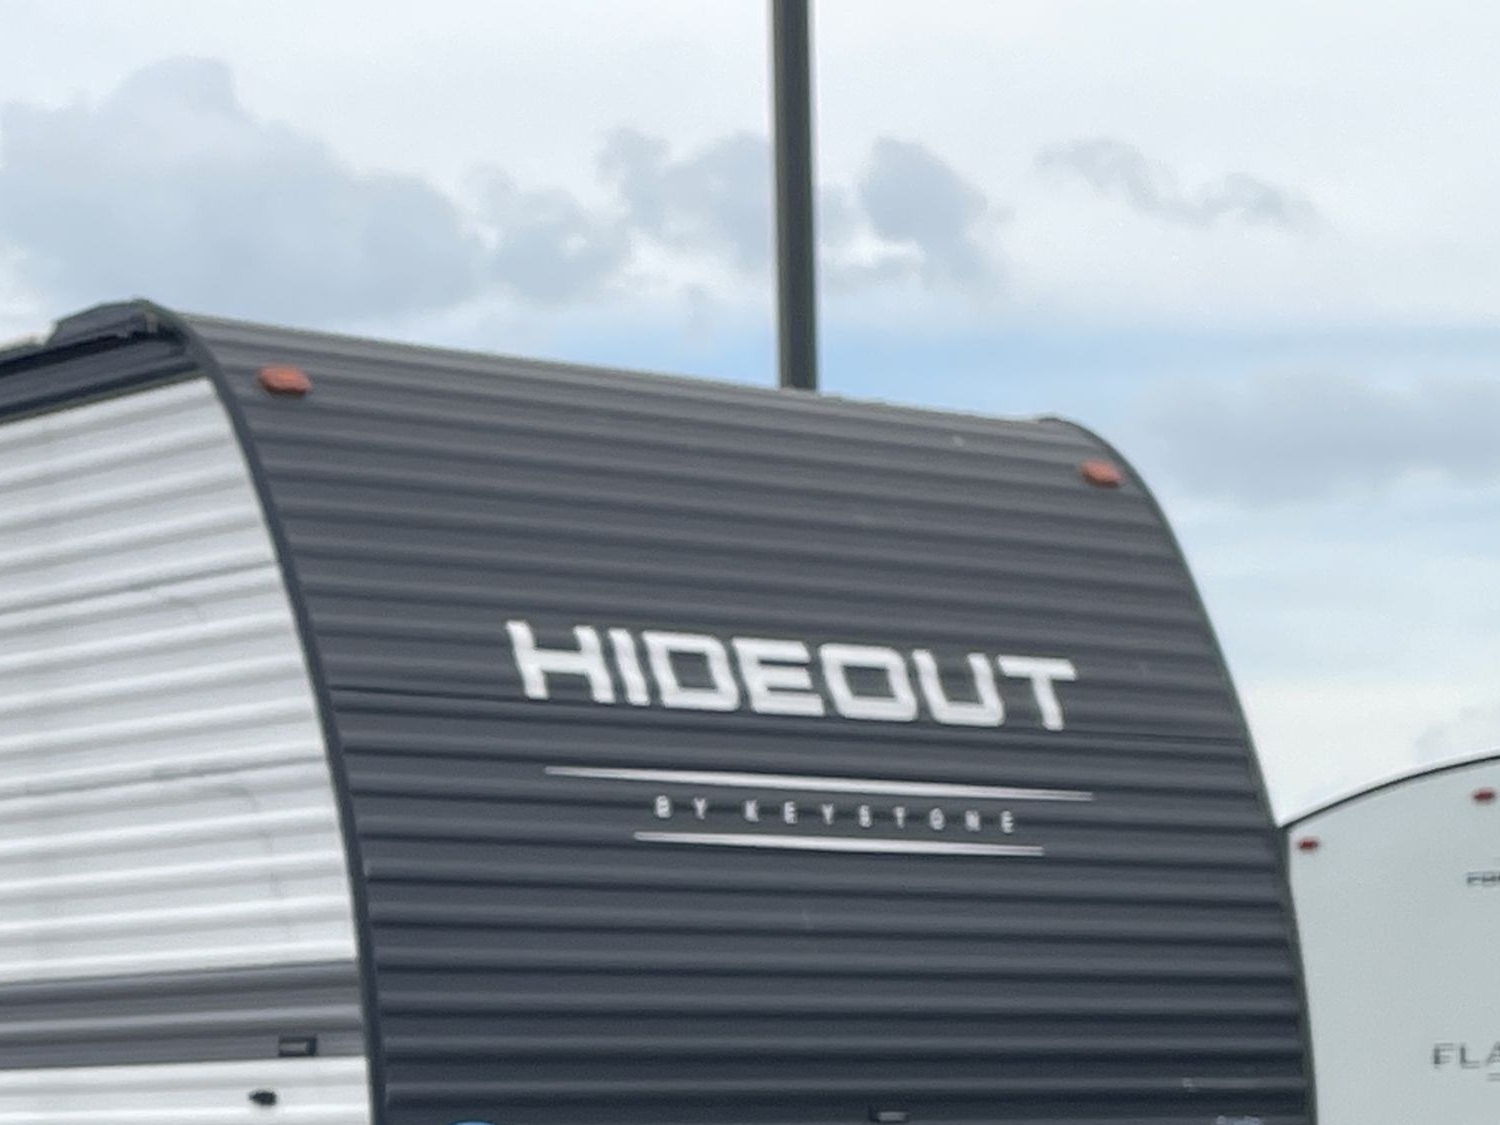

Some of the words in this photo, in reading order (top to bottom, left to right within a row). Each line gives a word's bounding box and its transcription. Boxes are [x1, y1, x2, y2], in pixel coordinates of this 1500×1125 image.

[505, 619, 1077, 730] HIDEOUT
[653, 794, 707, 820] BY
[743, 798, 1014, 835] KEYSTONE
